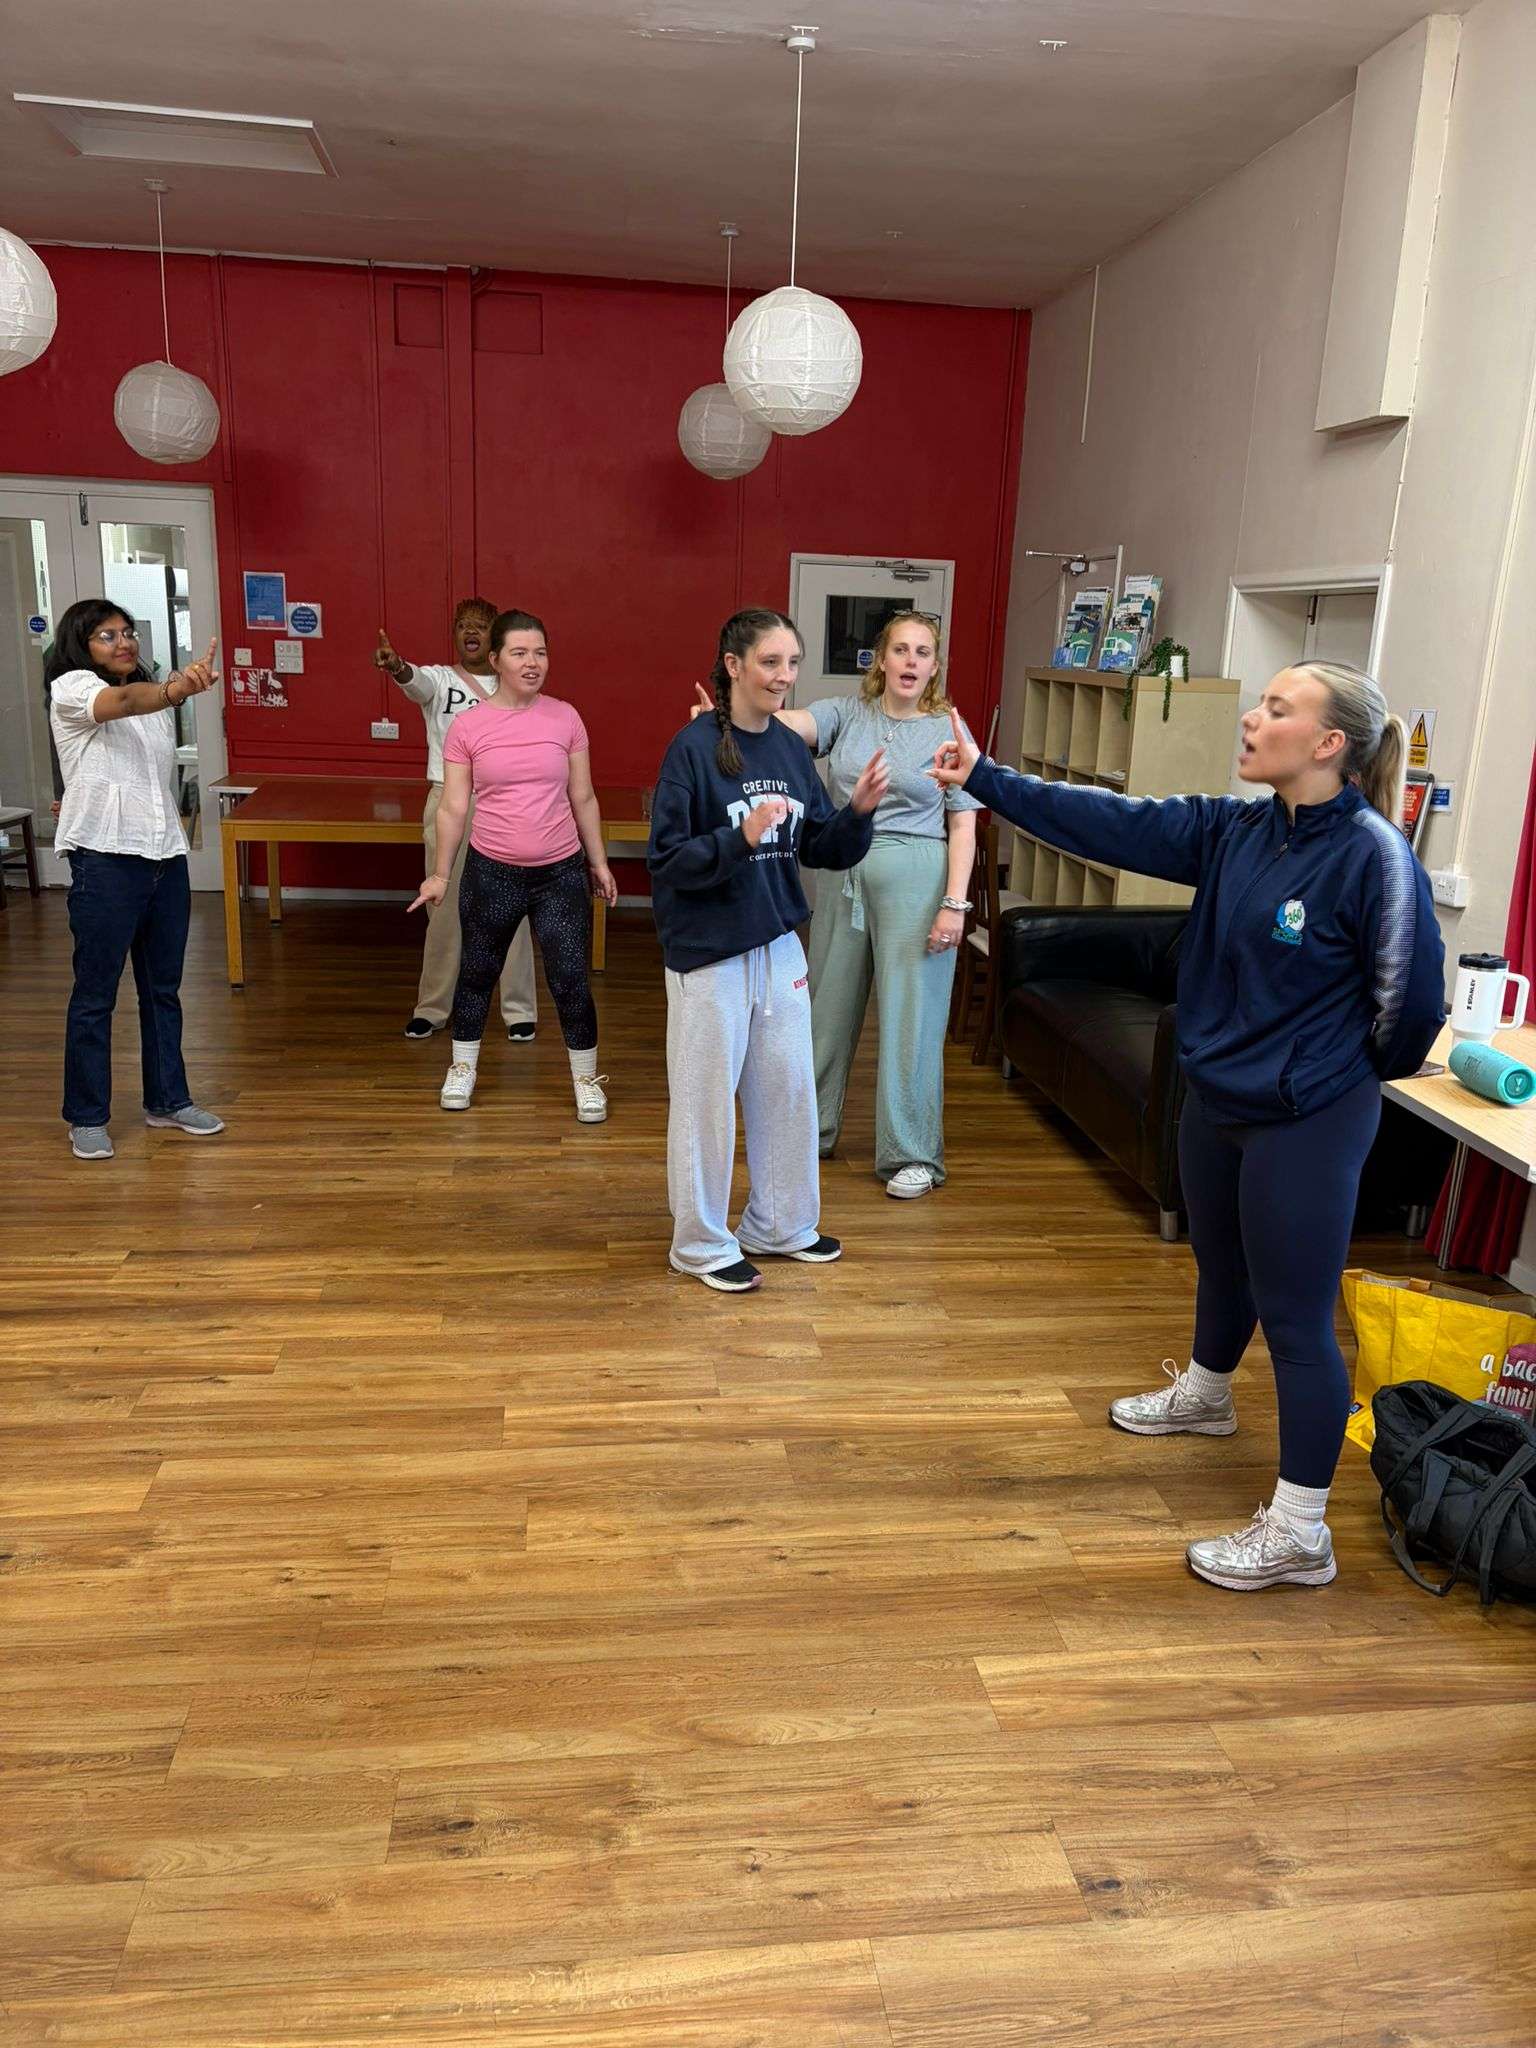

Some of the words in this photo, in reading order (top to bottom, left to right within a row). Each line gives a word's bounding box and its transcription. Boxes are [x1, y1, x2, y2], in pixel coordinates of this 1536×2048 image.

[742, 779, 789, 794] CREATIVE
[1467, 978, 1476, 1005] STANLEY
[1480, 1353, 1495, 1375] a
[1485, 1380, 1536, 1410] famil
